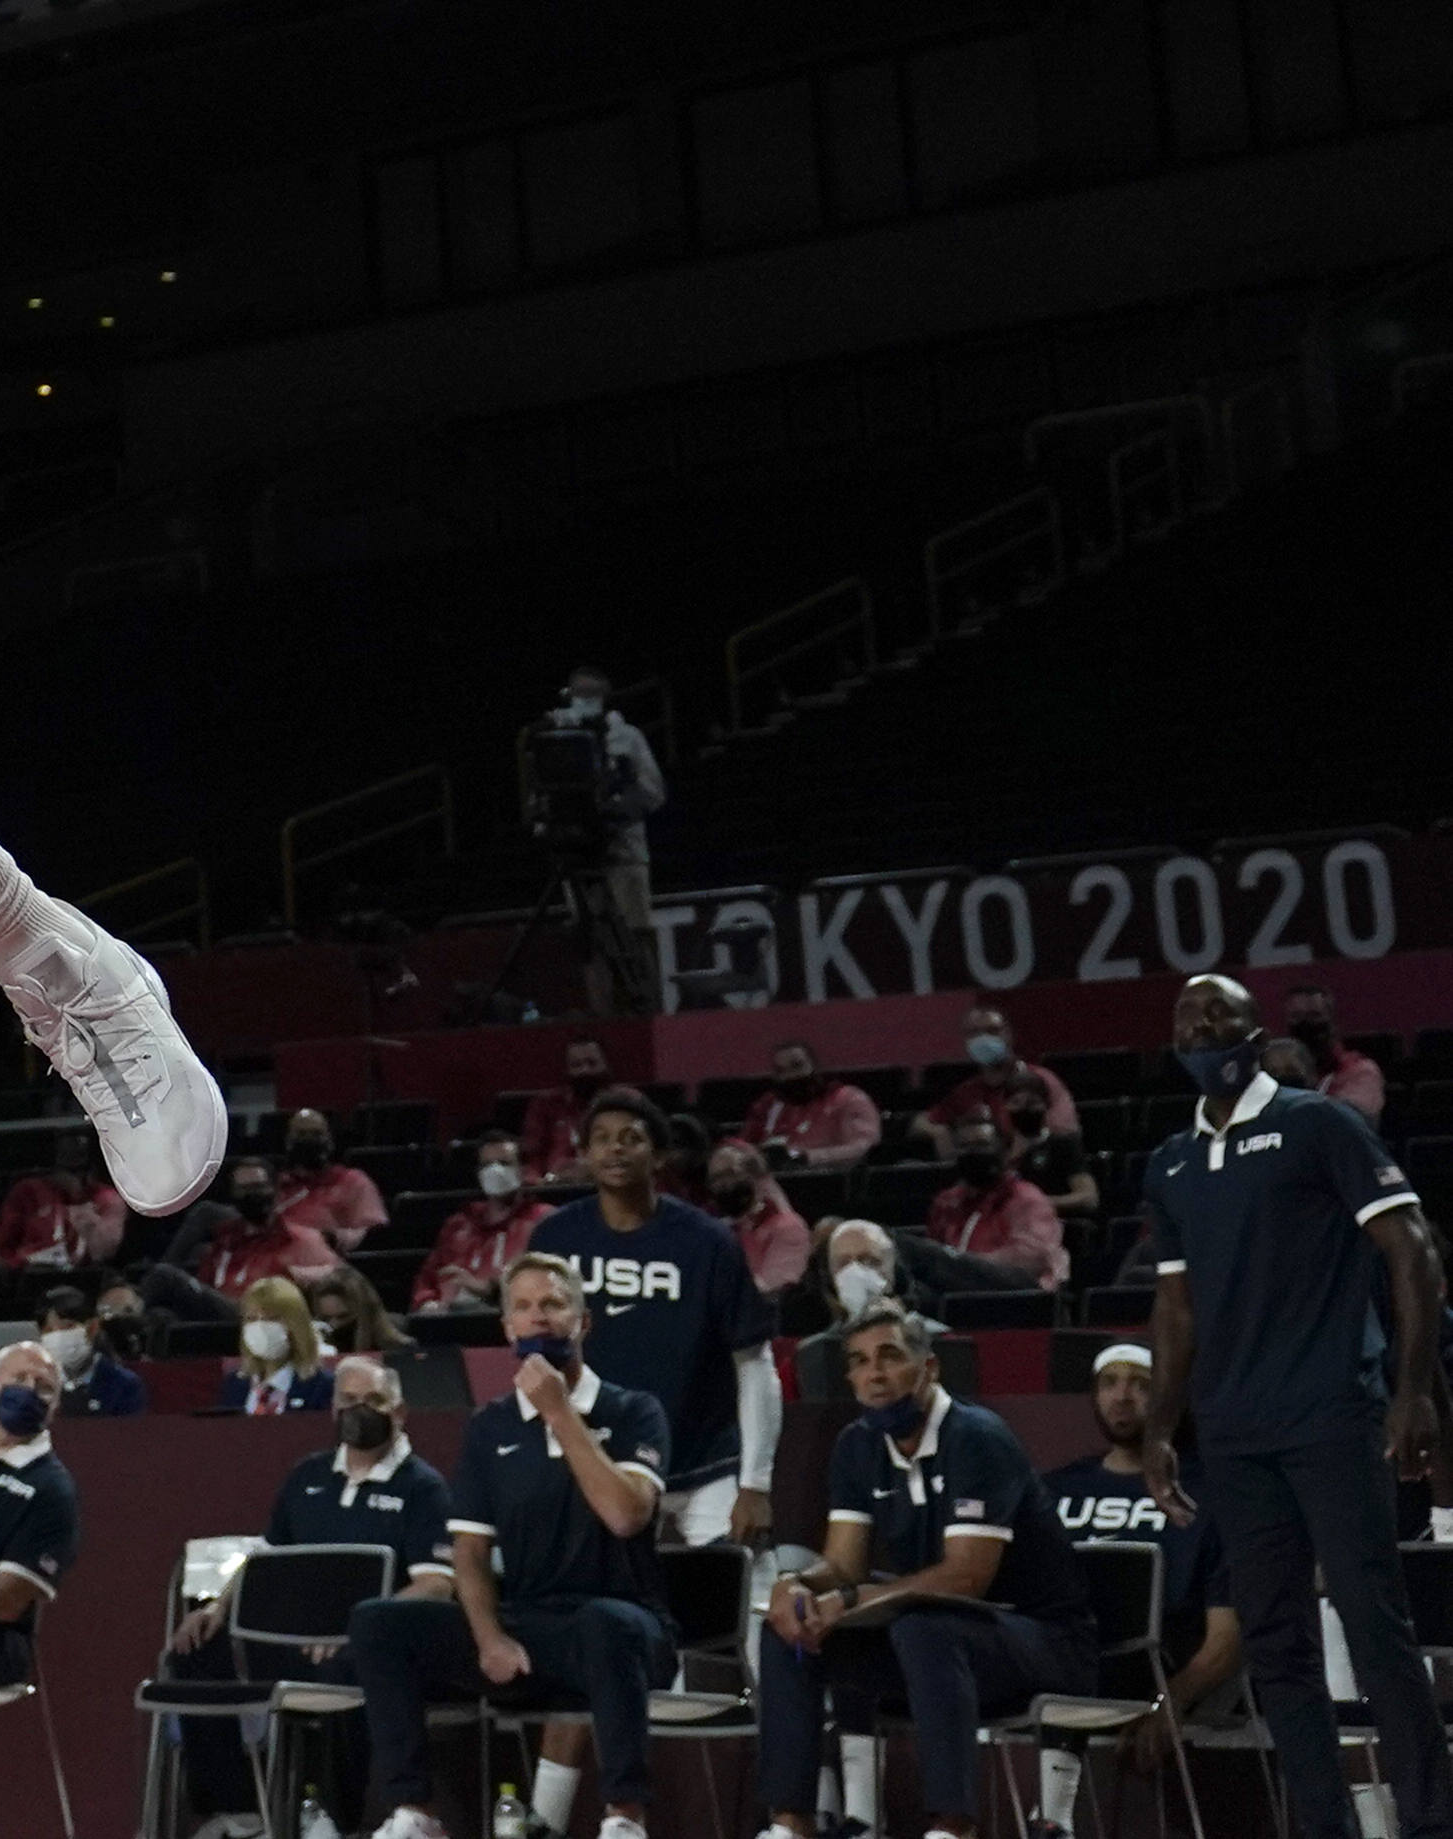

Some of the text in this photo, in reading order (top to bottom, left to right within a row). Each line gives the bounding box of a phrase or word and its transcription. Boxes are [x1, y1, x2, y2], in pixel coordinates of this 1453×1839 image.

[650, 837, 1399, 1016] TOKYO 2020
[1235, 1130, 1283, 1157] USA
[568, 1253, 683, 1302] USA
[1056, 1496, 1168, 1534] USA
